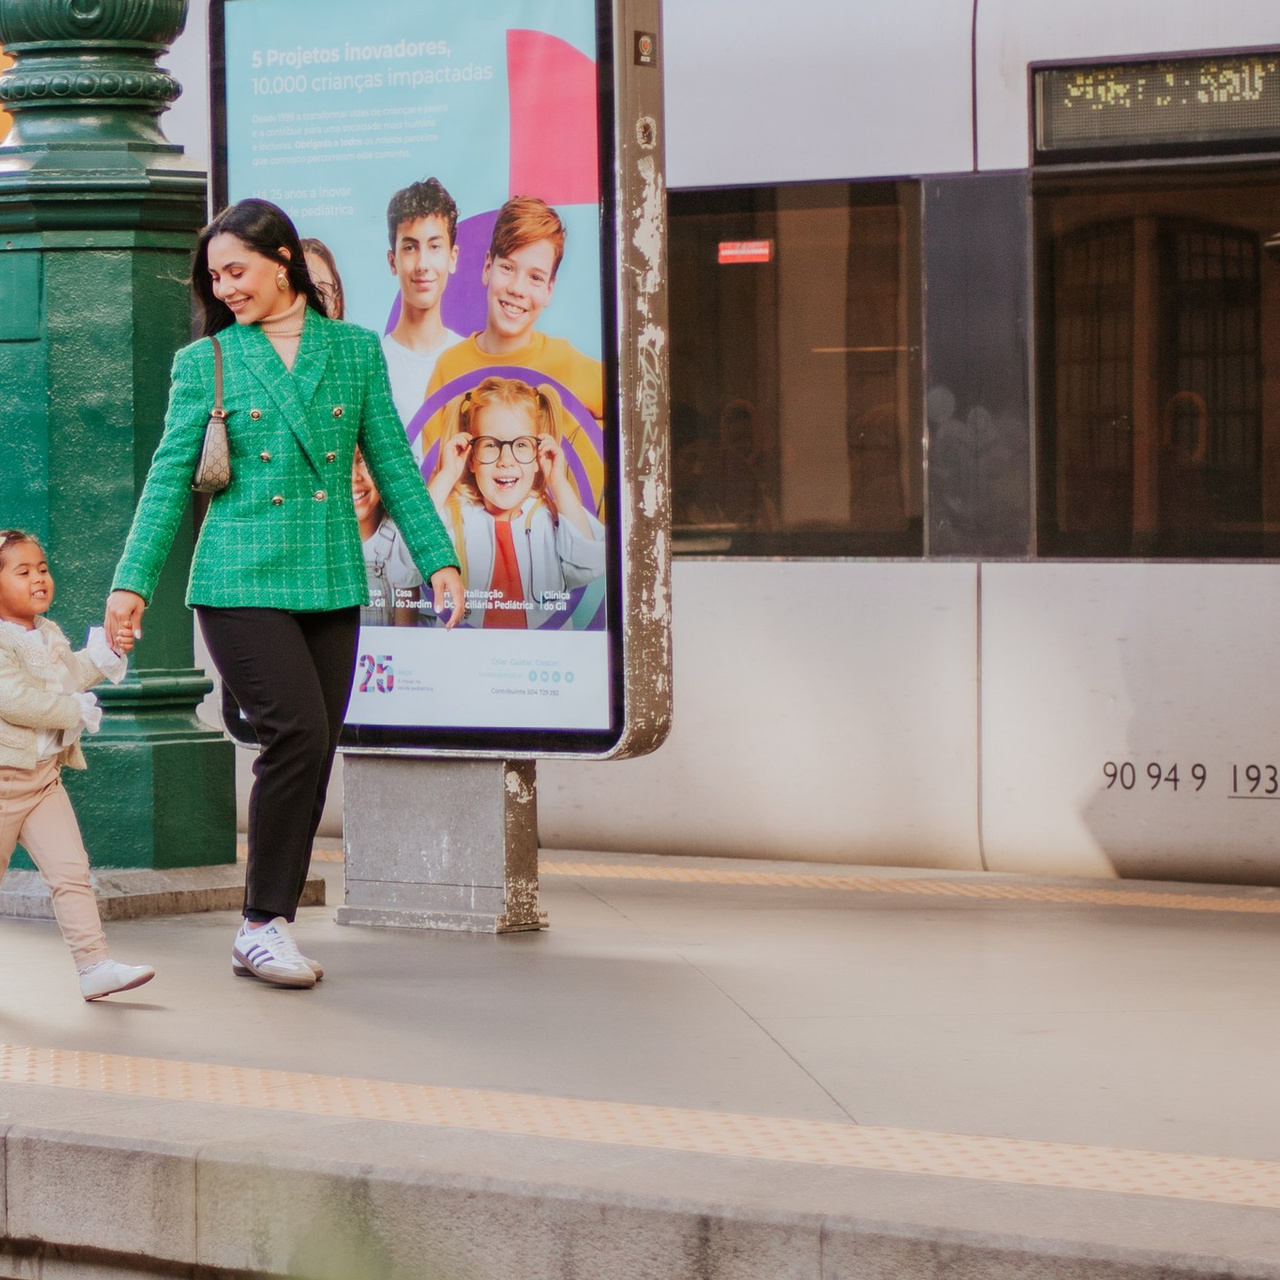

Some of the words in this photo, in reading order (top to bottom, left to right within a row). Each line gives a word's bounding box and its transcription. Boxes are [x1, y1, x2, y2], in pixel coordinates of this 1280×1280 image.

[252, 50, 262, 68] 5
[266, 45, 340, 69] Projetos
[344, 38, 451, 61] inovadores,
[252, 74, 307, 95] 10.000
[311, 71, 383, 94] crianças
[388, 61, 493, 89] impactadas
[302, 110, 348, 120] transformar
[349, 108, 369, 117] vidas
[370, 107, 382, 116] de
[383, 106, 416, 116] crianças
[265, 127, 302, 137] contribuir
[304, 126, 322, 136] para
[322, 125, 341, 133] uma
[342, 122, 382, 132] sociedade
[383, 121, 403, 129] mais
[294, 138, 333, 150] Obrigada
[340, 137, 363, 147] todos
[252, 158, 269, 167] que
[252, 188, 267, 199] Há
[269, 189, 283, 200] 25
[284, 190, 307, 199] anos
[309, 189, 317, 198] a
[319, 186, 351, 198] inovar
[301, 203, 354, 218] pediátrica
[395, 588, 412, 597] Casa
[544, 590, 570, 600] Clínica
[375, 597, 386, 608] Gil
[395, 599, 405, 608] do
[405, 599, 432, 609] Jardim
[494, 600, 534, 610] Pediátrica
[544, 601, 554, 611] do
[555, 602, 566, 611] Gil
[359, 654, 394, 693] 25
[491, 687, 526, 695] Contribuinte
[1103, 761, 1136, 790] 90
[1147, 761, 1180, 791] 94
[1191, 763, 1207, 792] 9
[1233, 764, 1279, 794] 193
